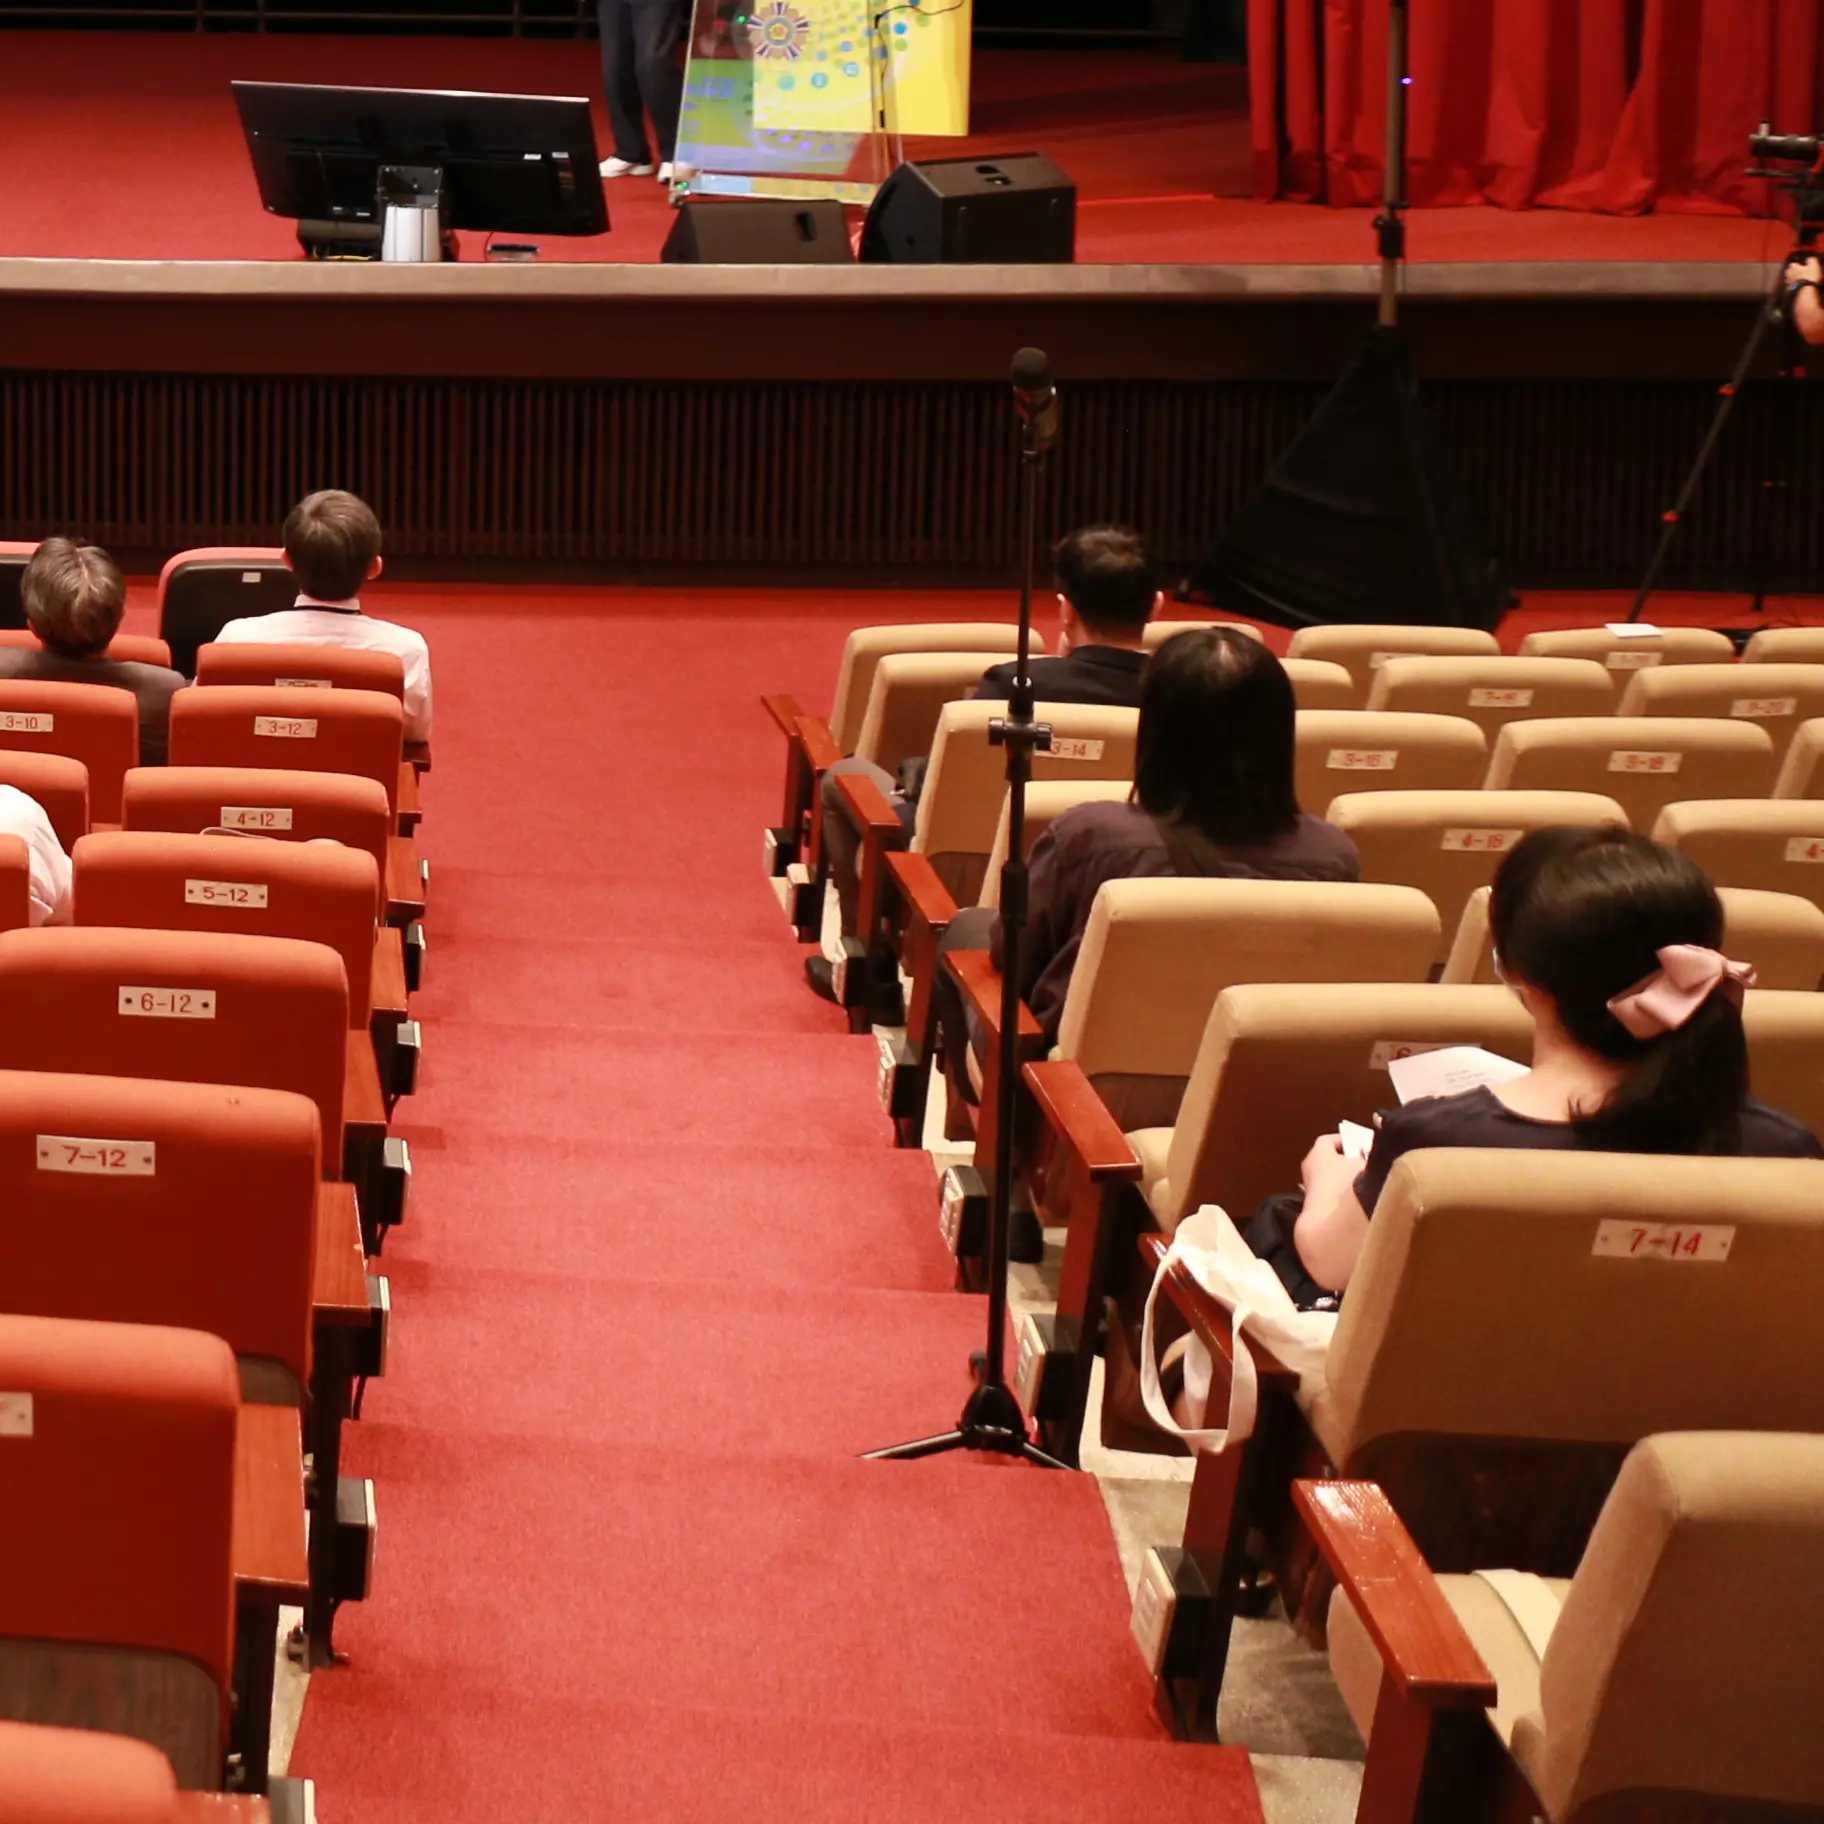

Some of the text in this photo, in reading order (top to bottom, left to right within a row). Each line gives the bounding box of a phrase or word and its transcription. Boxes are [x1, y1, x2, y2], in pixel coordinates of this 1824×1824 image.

[4, 714, 39, 731] 3-10
[267, 719, 303, 736] 3-12
[1050, 741, 1088, 757] 3-14
[236, 810, 275, 827] 4-12
[202, 884, 250, 903] 5-12
[140, 991, 193, 1014] 6-12
[62, 1145, 127, 1171] 7-12
[1627, 1228, 1702, 1256] 7-14
